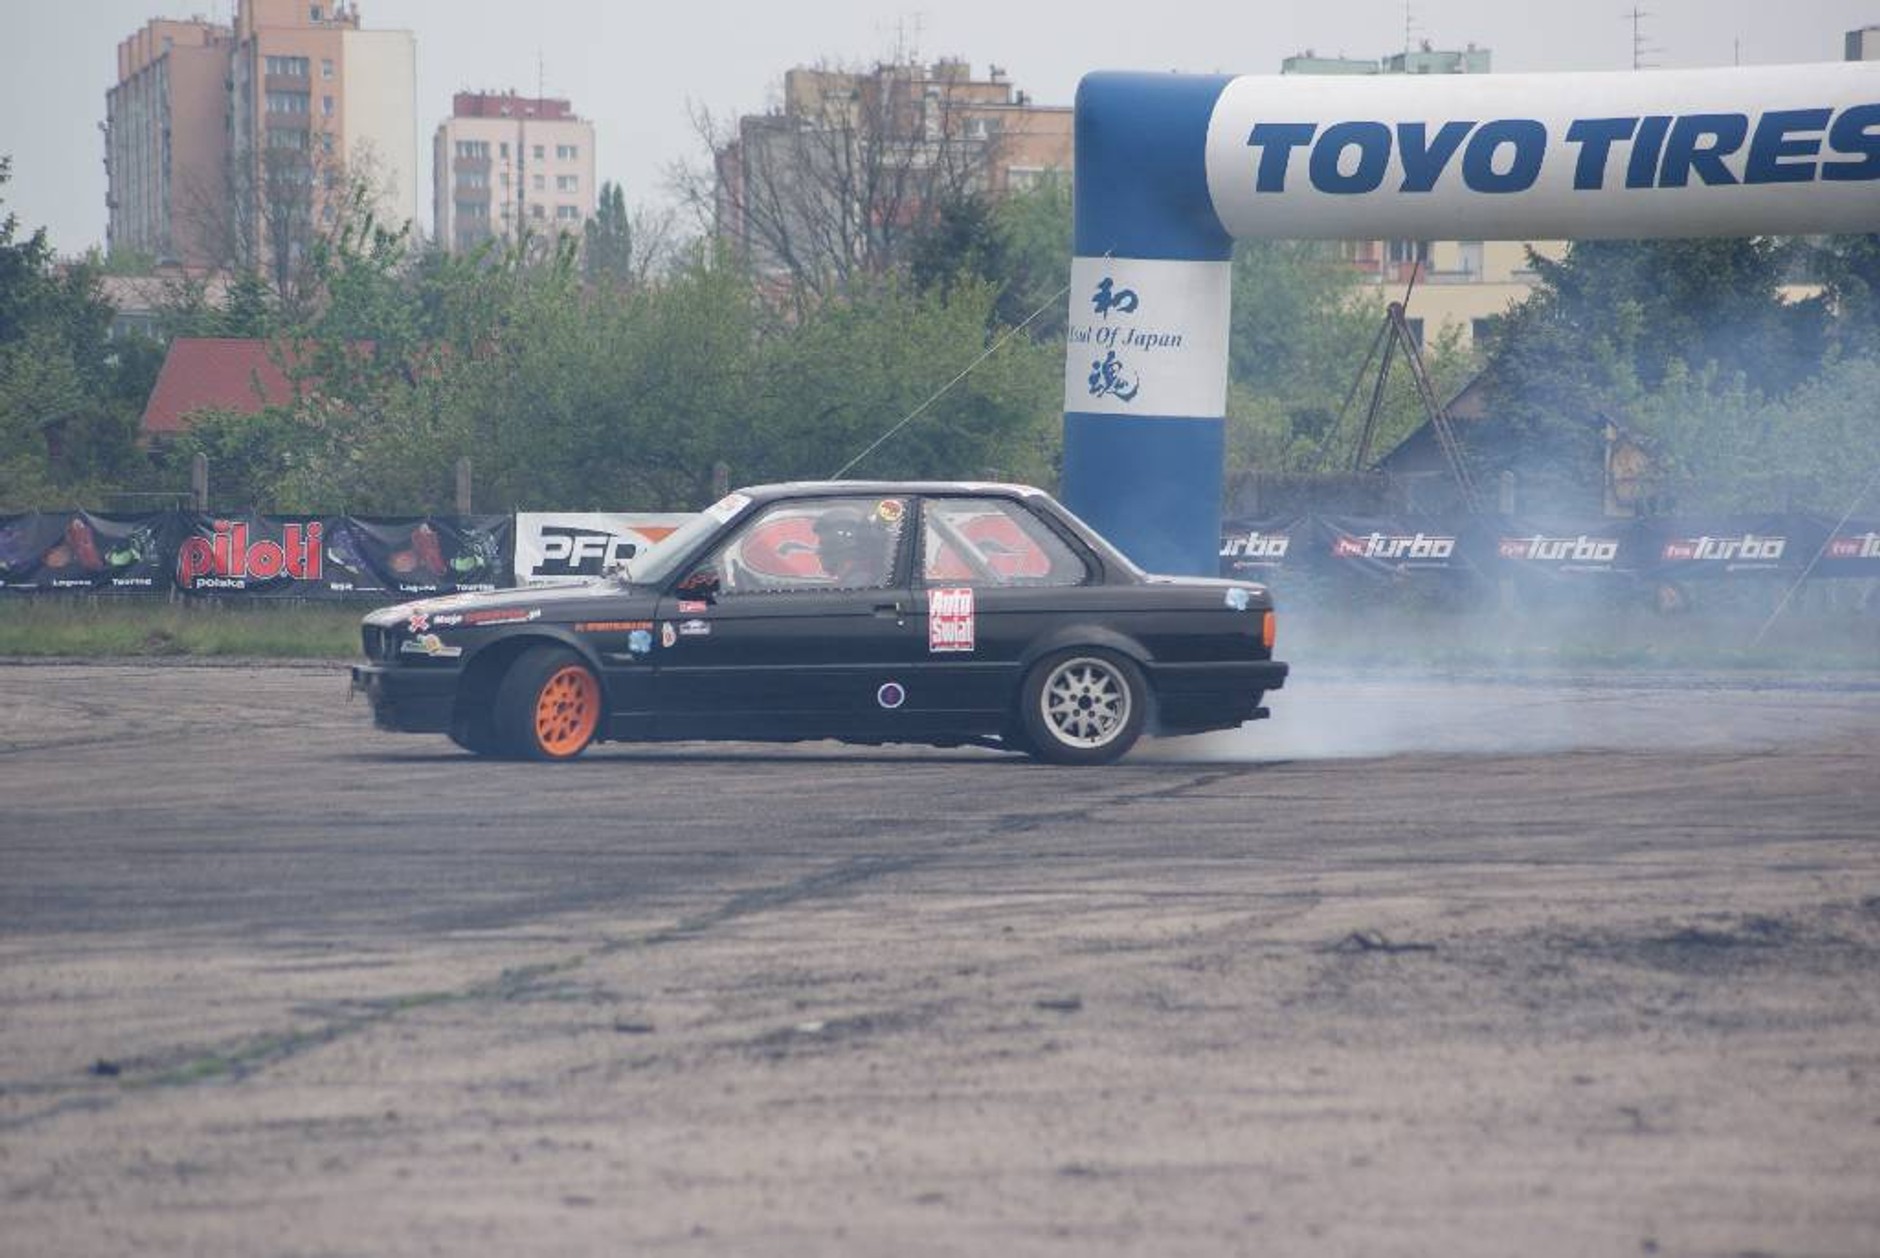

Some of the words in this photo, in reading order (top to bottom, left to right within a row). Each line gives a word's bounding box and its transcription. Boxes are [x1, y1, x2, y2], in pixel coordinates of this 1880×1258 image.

[1247, 119, 1547, 194] TOYO
[1565, 104, 1880, 189] TIRES
[1091, 277, 1139, 320] 和
[1096, 327, 1119, 348] Of
[1122, 327, 1183, 350] Japan
[177, 519, 322, 588] piloti
[1360, 532, 1455, 558] turbo
[1527, 535, 1618, 560] turbo
[1692, 535, 1786, 559] turbo
